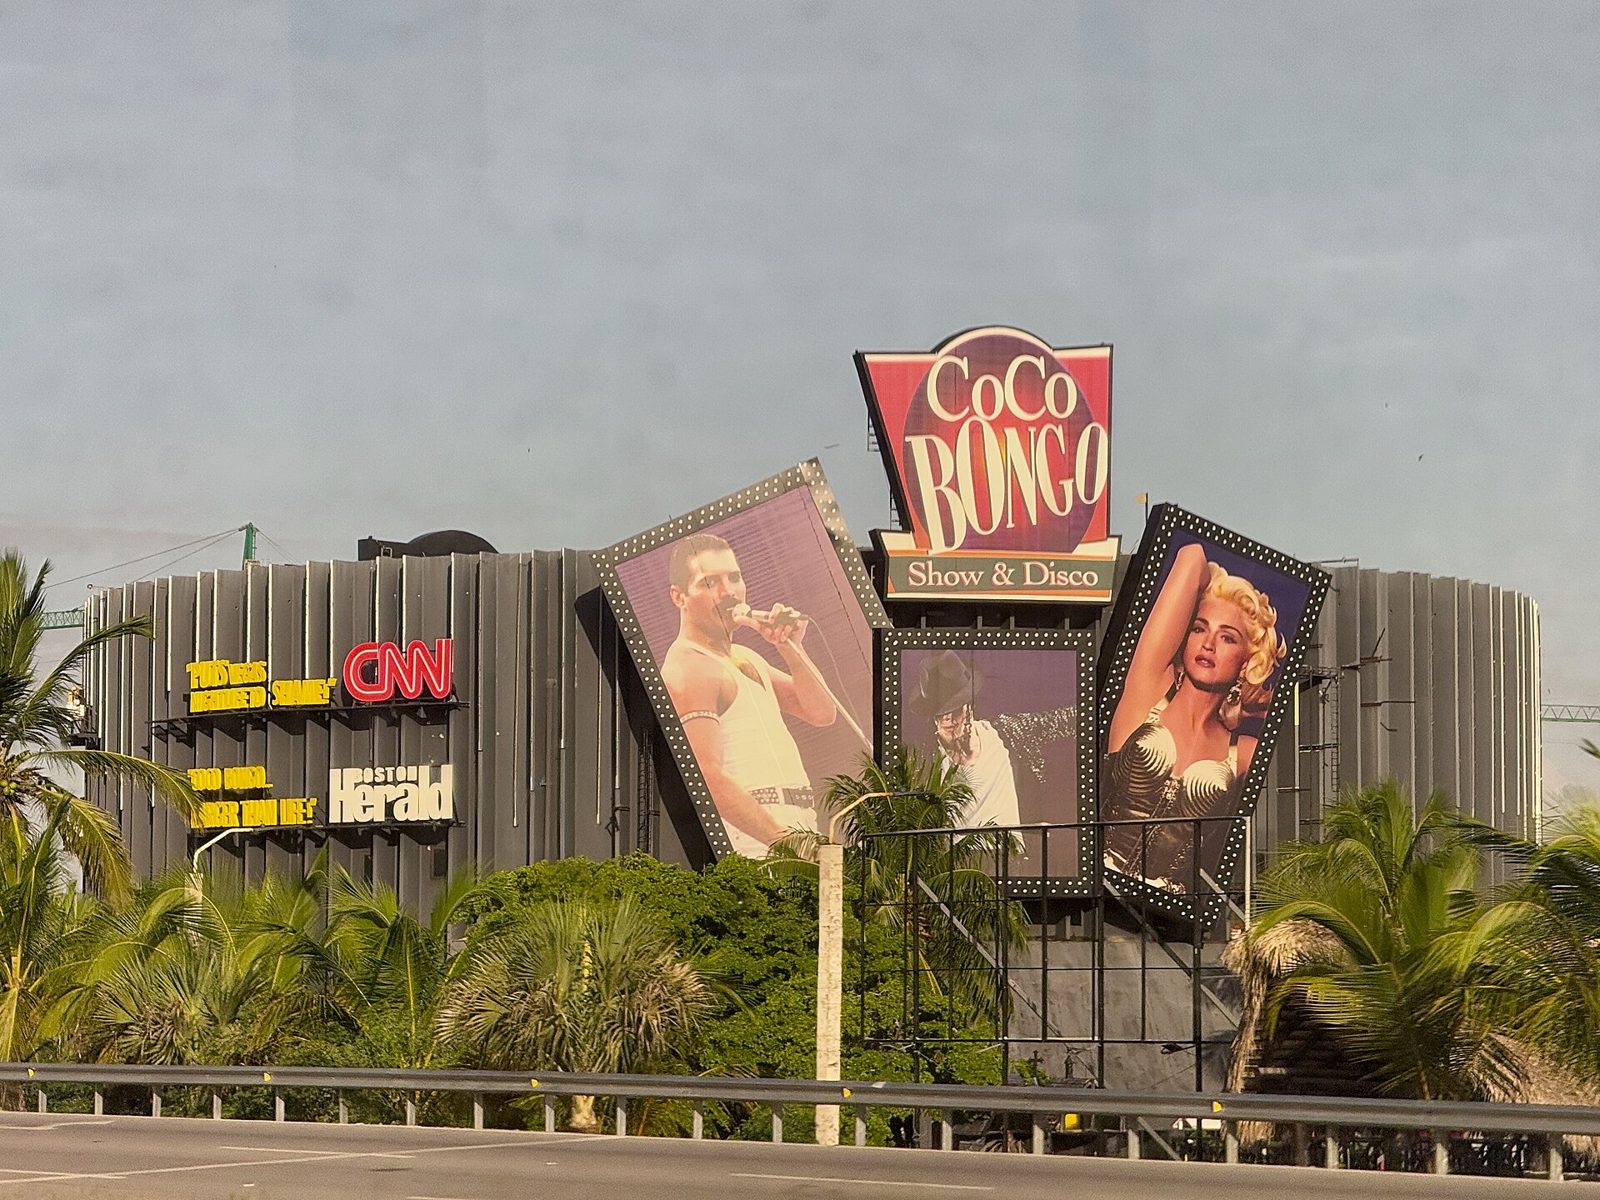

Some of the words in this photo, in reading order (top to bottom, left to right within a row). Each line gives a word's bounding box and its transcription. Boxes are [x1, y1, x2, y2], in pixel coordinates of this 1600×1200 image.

[904, 416, 1108, 555] BONGO
[908, 561, 985, 587] Show
[992, 562, 1016, 587] &
[1023, 561, 1098, 587] Disco
[343, 638, 454, 702] CNN
[329, 764, 453, 824] Herald
[354, 766, 418, 784] BOSTON
[240, 800, 277, 826] THAN
